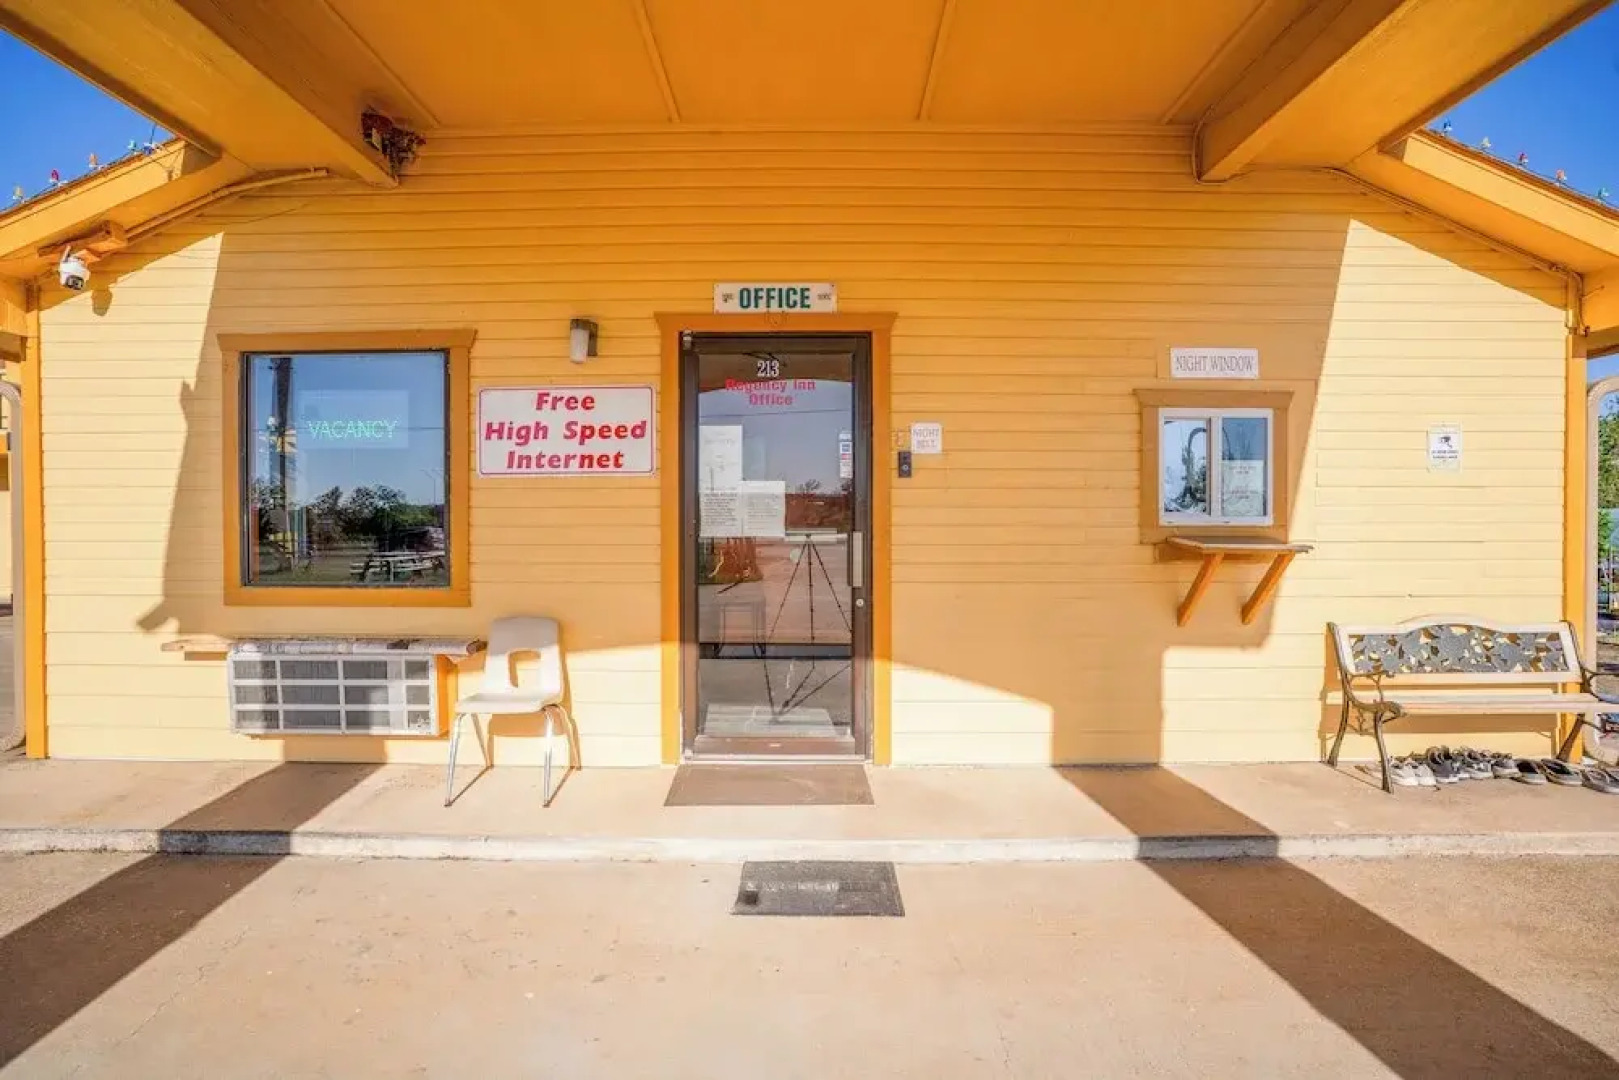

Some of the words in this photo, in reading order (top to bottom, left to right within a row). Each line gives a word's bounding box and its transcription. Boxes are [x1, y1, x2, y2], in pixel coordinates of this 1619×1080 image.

[739, 287, 811, 309] OFFICE
[756, 360, 780, 378] 213
[1175, 355, 1207, 372] NIGHT
[1208, 355, 1254, 372] WINDOW
[724, 378, 788, 393] Regency
[794, 380, 817, 391] Inn
[535, 391, 596, 411] Free
[749, 393, 793, 406] Office
[306, 420, 398, 438] VACANCY
[484, 421, 549, 446] High
[563, 420, 648, 446] Speed
[506, 451, 625, 469] Internet
